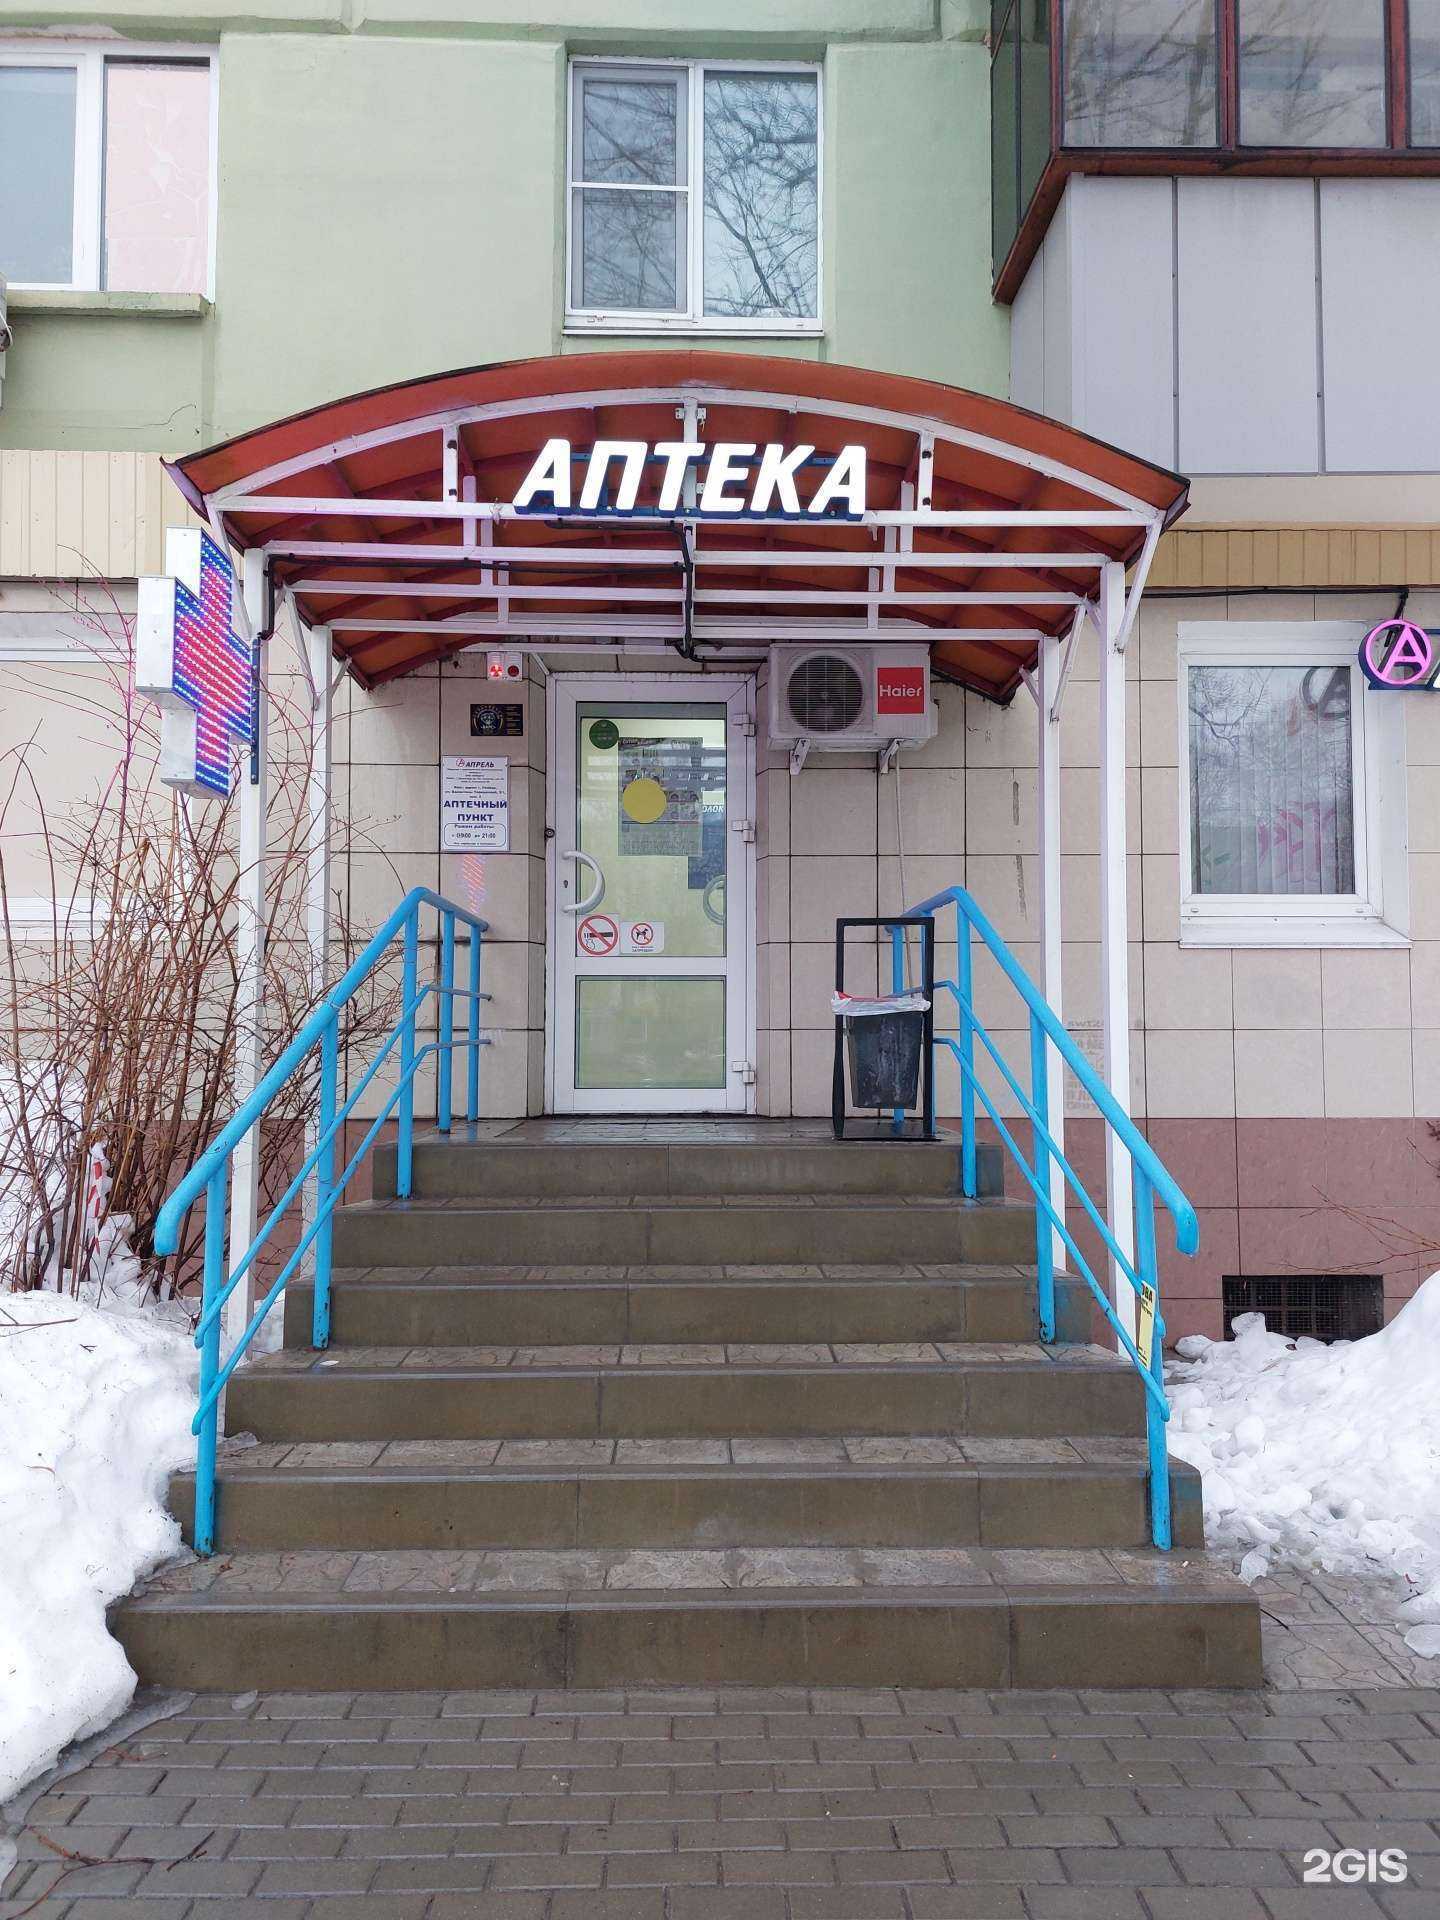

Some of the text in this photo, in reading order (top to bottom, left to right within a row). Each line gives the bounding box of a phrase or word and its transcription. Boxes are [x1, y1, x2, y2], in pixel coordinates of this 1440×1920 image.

[512, 438, 867, 519] АПТЕКА
[879, 684, 922, 697] Haier
[443, 800, 507, 808] АПТЕЧНЫЙ
[457, 813, 494, 822] ПУНКТ
